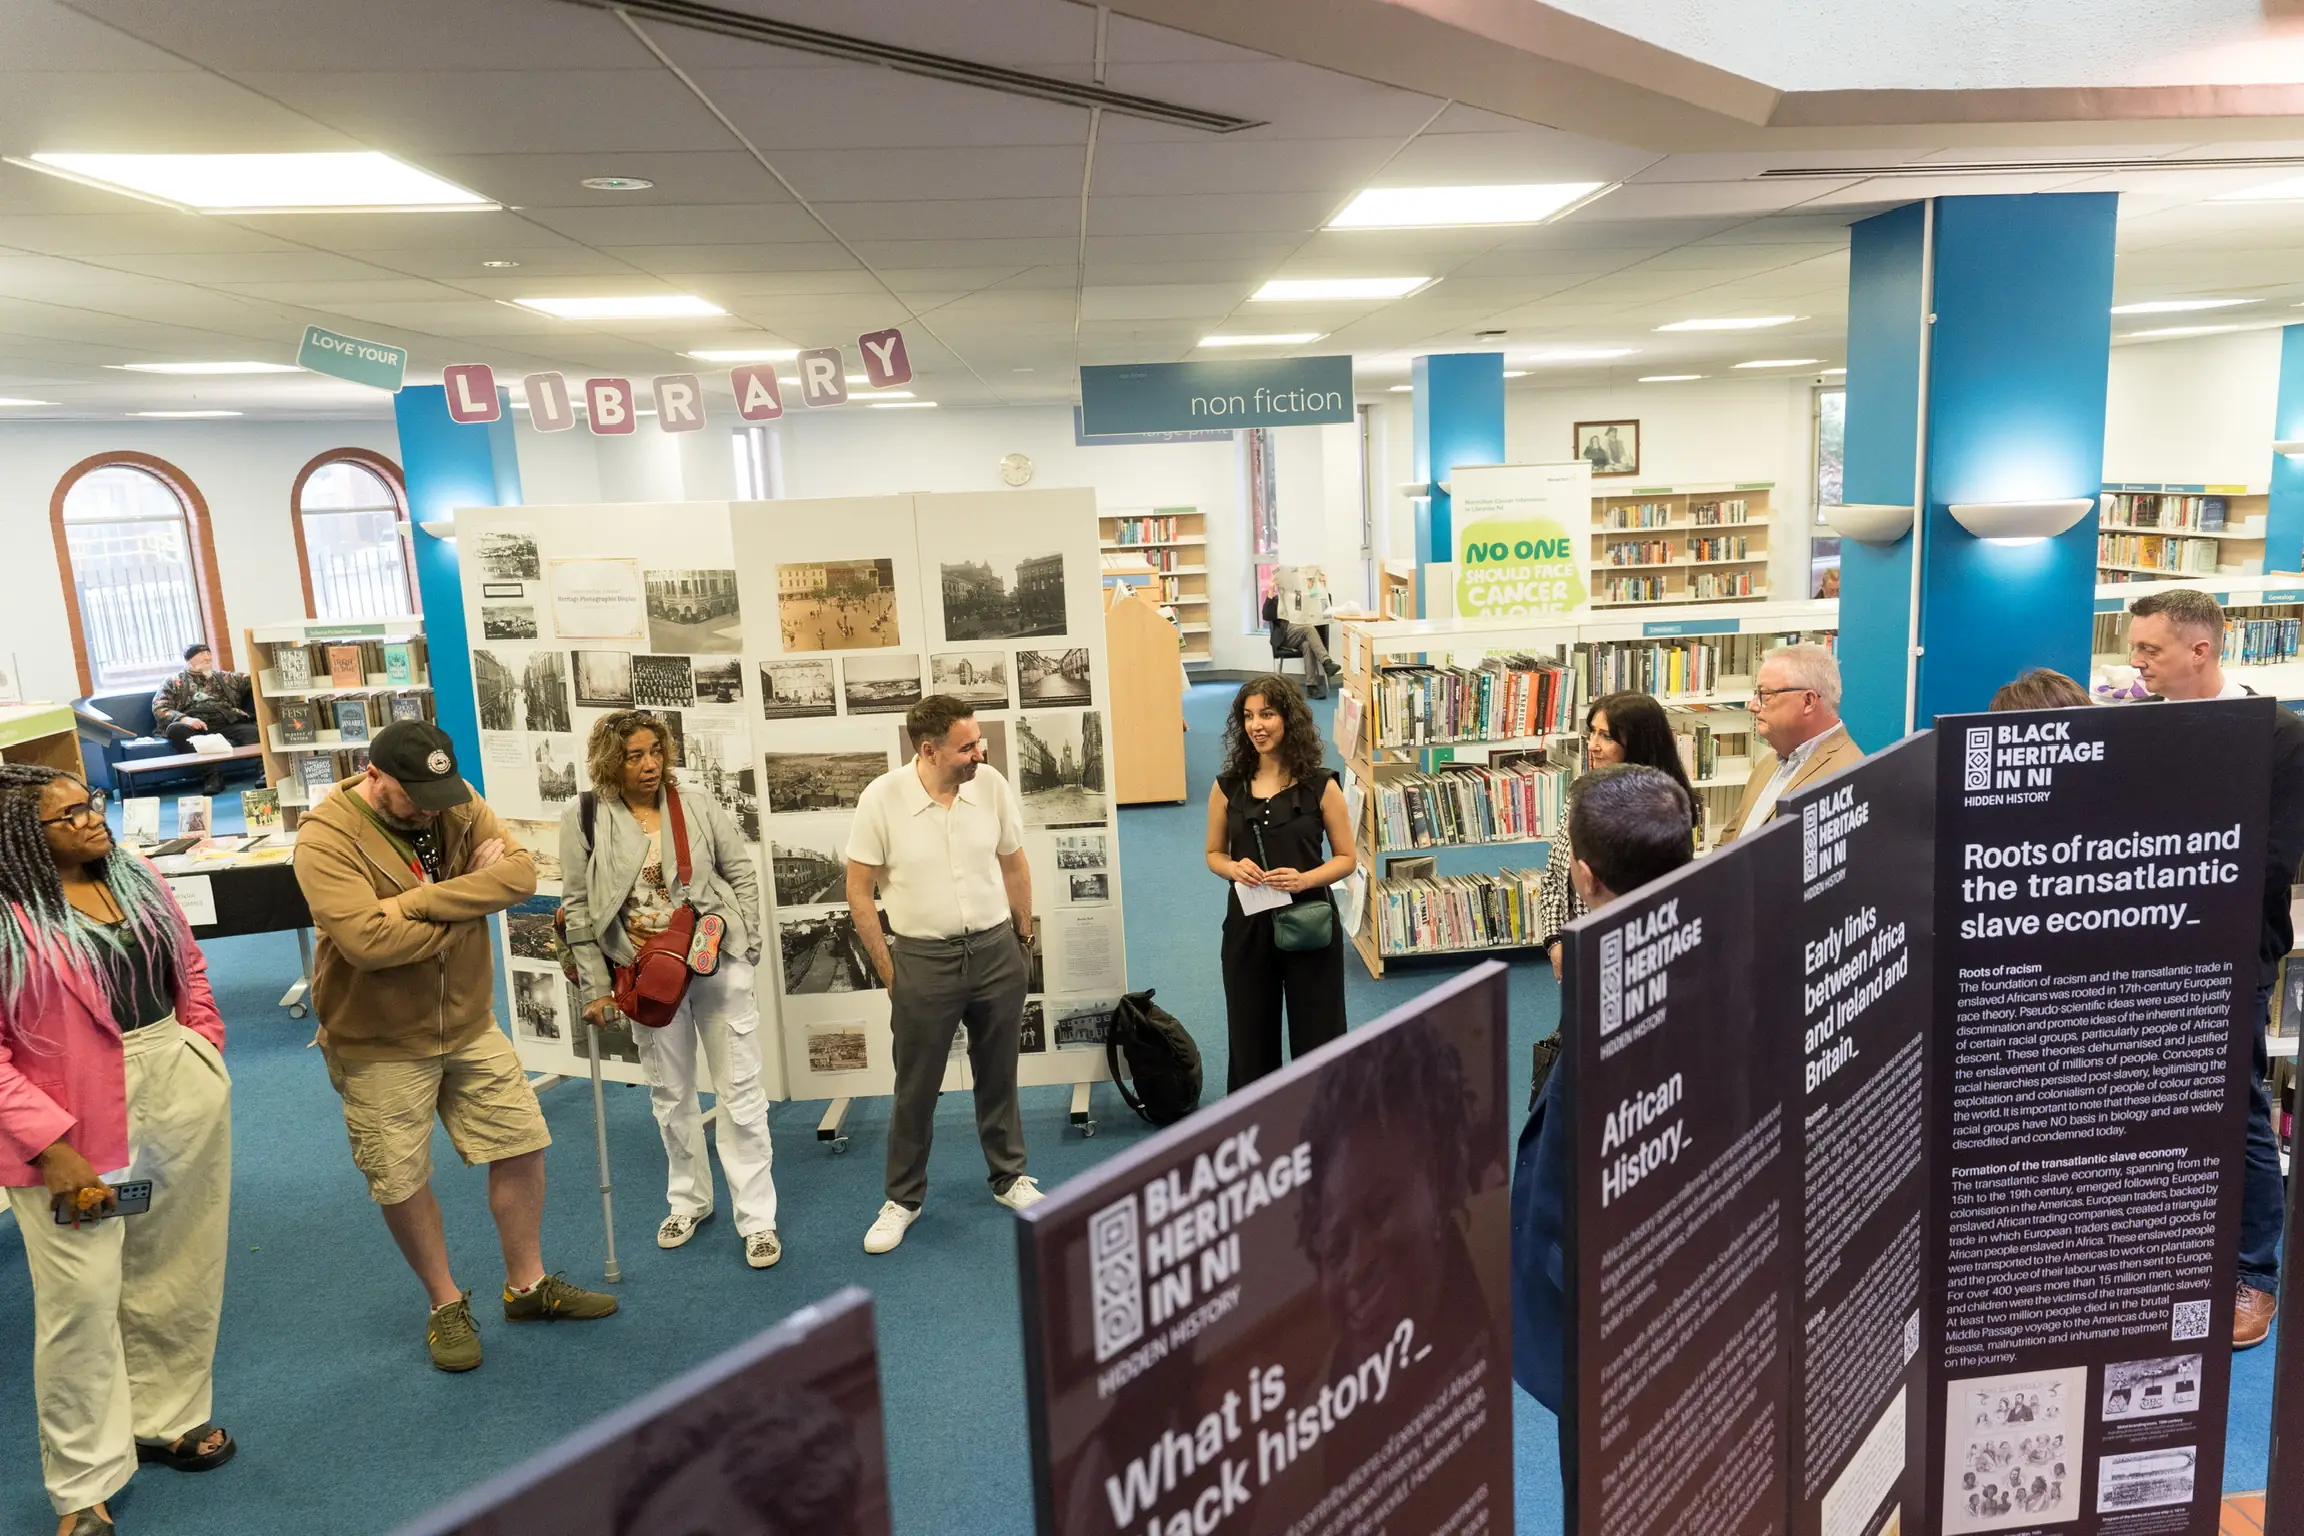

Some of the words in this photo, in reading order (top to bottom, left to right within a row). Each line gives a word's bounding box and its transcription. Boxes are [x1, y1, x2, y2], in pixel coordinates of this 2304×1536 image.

[311, 333, 354, 356] LOVE
[357, 344, 398, 366] YOUR
[1191, 396, 1245, 416] non
[1254, 388, 1342, 413] fiction
[1466, 542, 1508, 564] NO
[1514, 538, 1570, 559] ONE
[1465, 566, 1530, 585] SHOULD
[1534, 563, 1573, 580] FACE
[1468, 580, 1568, 606] CANCER
[282, 707, 308, 719] FEIST
[1998, 722, 2070, 744] BLACK
[1996, 741, 2104, 767] HERITAGE
[1996, 770, 2021, 789] IN
[2027, 768, 2052, 786] NI
[1819, 784, 1854, 822] BLACK
[1964, 794, 2004, 807] HIDDEN
[2006, 791, 2051, 804] HISTORY
[1819, 802, 1869, 847] HERITAGE
[1819, 846, 1832, 875] IN
[1834, 839, 1846, 866] NI
[1964, 842, 2047, 870] Roots
[2052, 835, 2082, 864] of
[2086, 831, 2182, 861] racism
[2186, 824, 2240, 854] and
[1804, 881, 1824, 902] HIDDEN
[1824, 868, 1846, 891] HISTORY
[1962, 876, 2017, 902] the
[2028, 858, 2240, 898] transatlantic
[1625, 898, 1680, 952] BLACK
[1805, 926, 1843, 976] Early
[1844, 905, 1876, 945] links
[1960, 912, 2040, 940] slave
[1624, 918, 1702, 987] HERITAGE
[1804, 949, 1868, 1016] between
[1869, 921, 1906, 970] Africa
[1958, 981, 1978, 992] The
[1981, 976, 2037, 990] foundation
[2039, 975, 2050, 986] of
[2053, 972, 2086, 984] racism
[2089, 971, 2109, 982] and
[2112, 969, 2129, 980] the
[2131, 964, 2192, 978] transatlantic
[2194, 962, 2221, 973] trade
[2223, 961, 2232, 971] in
[1959, 966, 1990, 978] Roots
[1992, 965, 2004, 975] of
[2005, 962, 2042, 974] racism
[1625, 984, 1645, 1022] IN
[1648, 970, 1668, 1006] NI
[1805, 1014, 1834, 1054] and
[1836, 972, 1882, 1032] Ireland
[1885, 946, 1908, 991] and
[1957, 993, 2004, 1007] enslaved
[2006, 990, 2047, 1003] Africans
[2048, 990, 2069, 999] was
[2071, 985, 2105, 997] rooted
[2106, 984, 2116, 994] in
[2183, 975, 2231, 990] European
[1957, 1012, 1980, 1021] race
[2107, 997, 2134, 1009] ideas
[2136, 997, 2161, 1006] were
[2163, 993, 2188, 1004] used
[2190, 992, 2200, 1002] to
[2202, 989, 2231, 1003] justify
[1600, 1028, 1632, 1060] HIDDEN
[1634, 1007, 1667, 1044] HISTORY
[1601, 1072, 1682, 1158] African
[1953, 1124, 1980, 1135] racial
[1982, 1122, 2019, 1135] groups
[2022, 1117, 2047, 1129] have
[2050, 1115, 2067, 1126] NO
[2069, 1113, 2095, 1124] basis
[2098, 1112, 2107, 1122] in
[2110, 1108, 2148, 1123] biology
[2150, 1106, 2170, 1117] and
[2172, 1106, 2188, 1114] are
[2190, 1101, 2223, 1115] widely
[1952, 1135, 2008, 1149] discredited
[2010, 1133, 2030, 1144] and
[2032, 1127, 2094, 1142] condemned
[1144, 1124, 1261, 1227] BLACK
[1952, 1162, 2006, 1177] Formation
[2008, 1161, 2020, 1171] of
[2021, 1159, 2039, 1170] the
[2041, 1153, 2107, 1168] transatlantic
[2109, 1150, 2137, 1161] slave
[2138, 1147, 2188, 1161] economy
[1952, 1193, 1973, 1204] 15th
[1976, 1192, 1986, 1202] to
[1989, 1190, 2005, 1201] the
[2009, 1188, 2031, 1199] 19th
[2076, 1179, 2121, 1194] emerged
[2124, 1174, 2169, 1189] following
[2171, 1169, 2218, 1185] European
[1146, 1141, 1312, 1276] HERITAGE
[1150, 1269, 1192, 1326] IN
[1202, 1233, 1240, 1294] NI
[1946, 1303, 1965, 1314] and
[1967, 1299, 2007, 1312] children
[2008, 1298, 2033, 1308] were
[2035, 1294, 2051, 1305] the
[2052, 1290, 2086, 1303] victims
[2087, 1289, 2098, 1299] of
[2099, 1287, 2115, 1298] the
[2116, 1281, 2174, 1296] transatlantic
[1098, 1336, 1168, 1398] HIDDEN
[1170, 1284, 1241, 1354] HISTORY
[1106, 1388, 1241, 1529] What
[1249, 1364, 1286, 1424] is
[1147, 1458, 1252, 1536] ack
